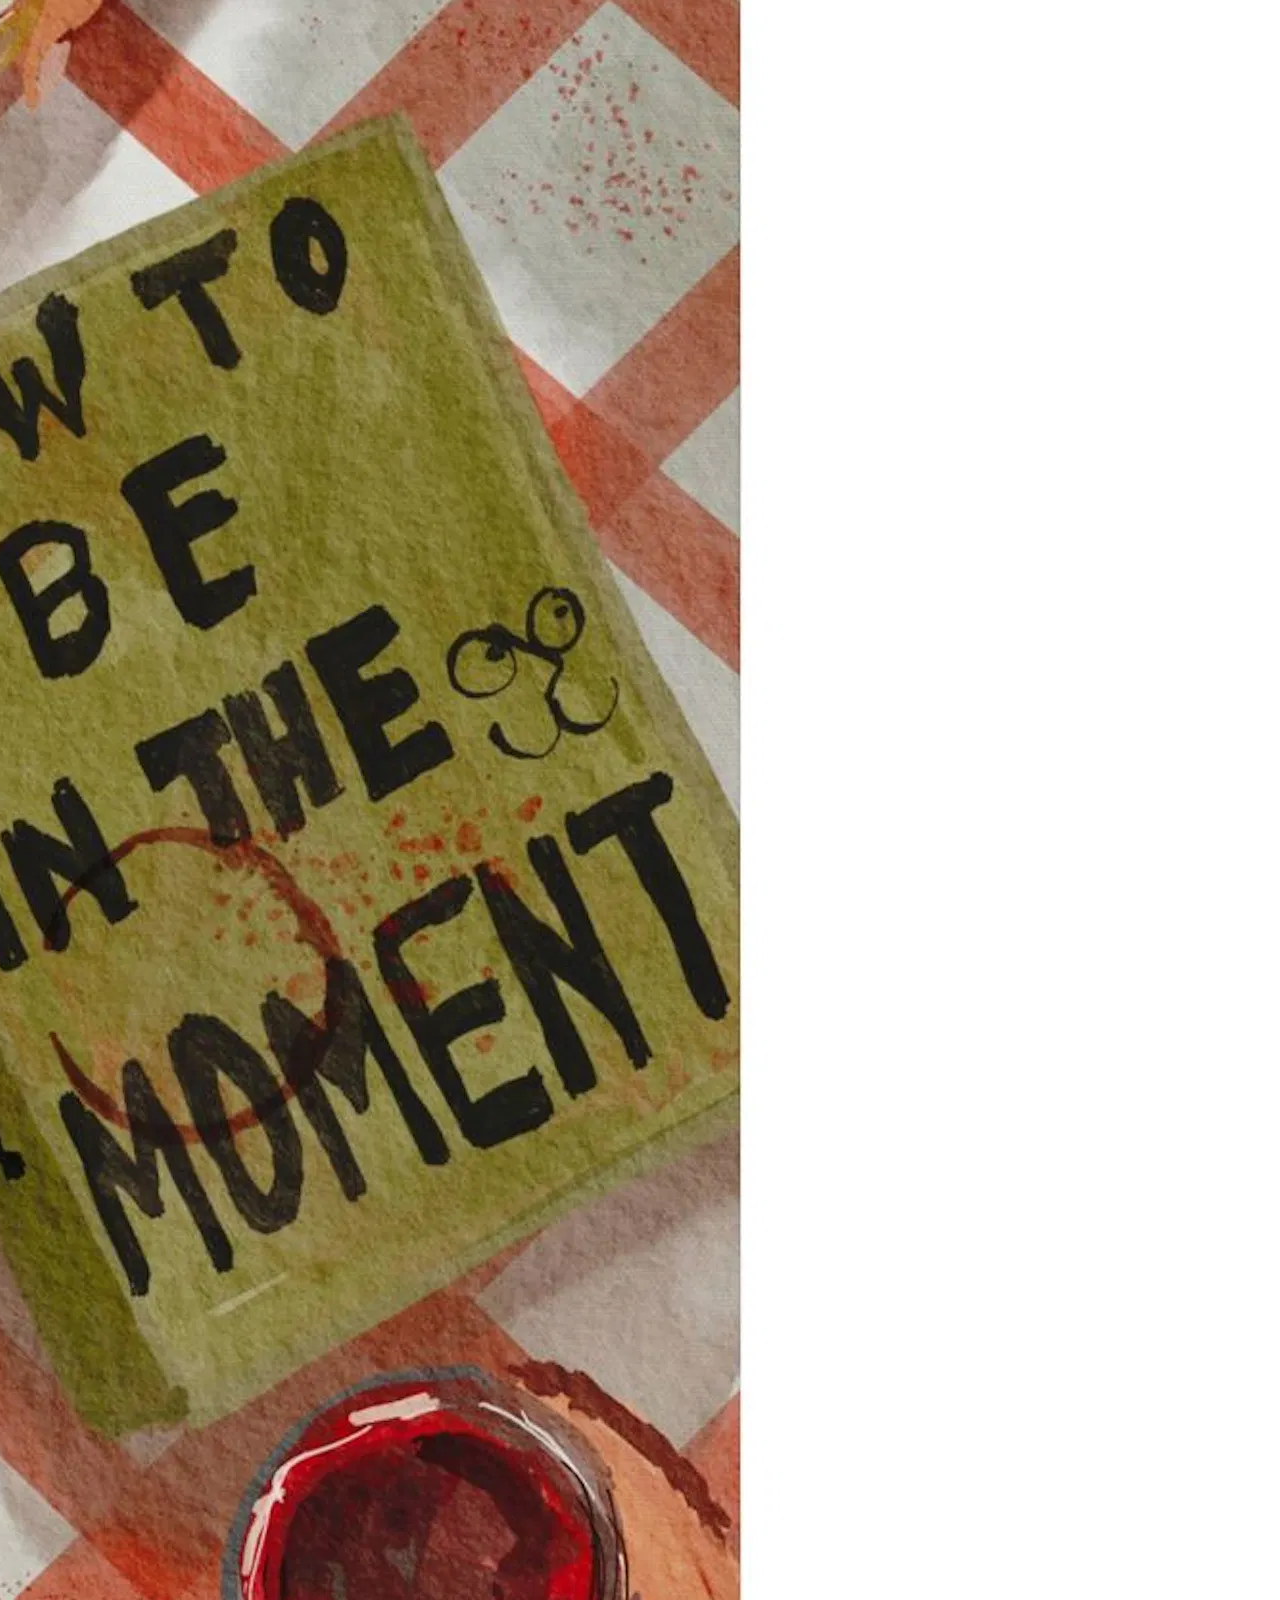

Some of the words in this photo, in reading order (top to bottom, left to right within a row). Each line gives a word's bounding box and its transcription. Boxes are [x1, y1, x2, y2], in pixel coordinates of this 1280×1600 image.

[130, 196, 349, 370] TO
[133, 603, 456, 850] THE
[56, 771, 731, 1298] MOMENT
